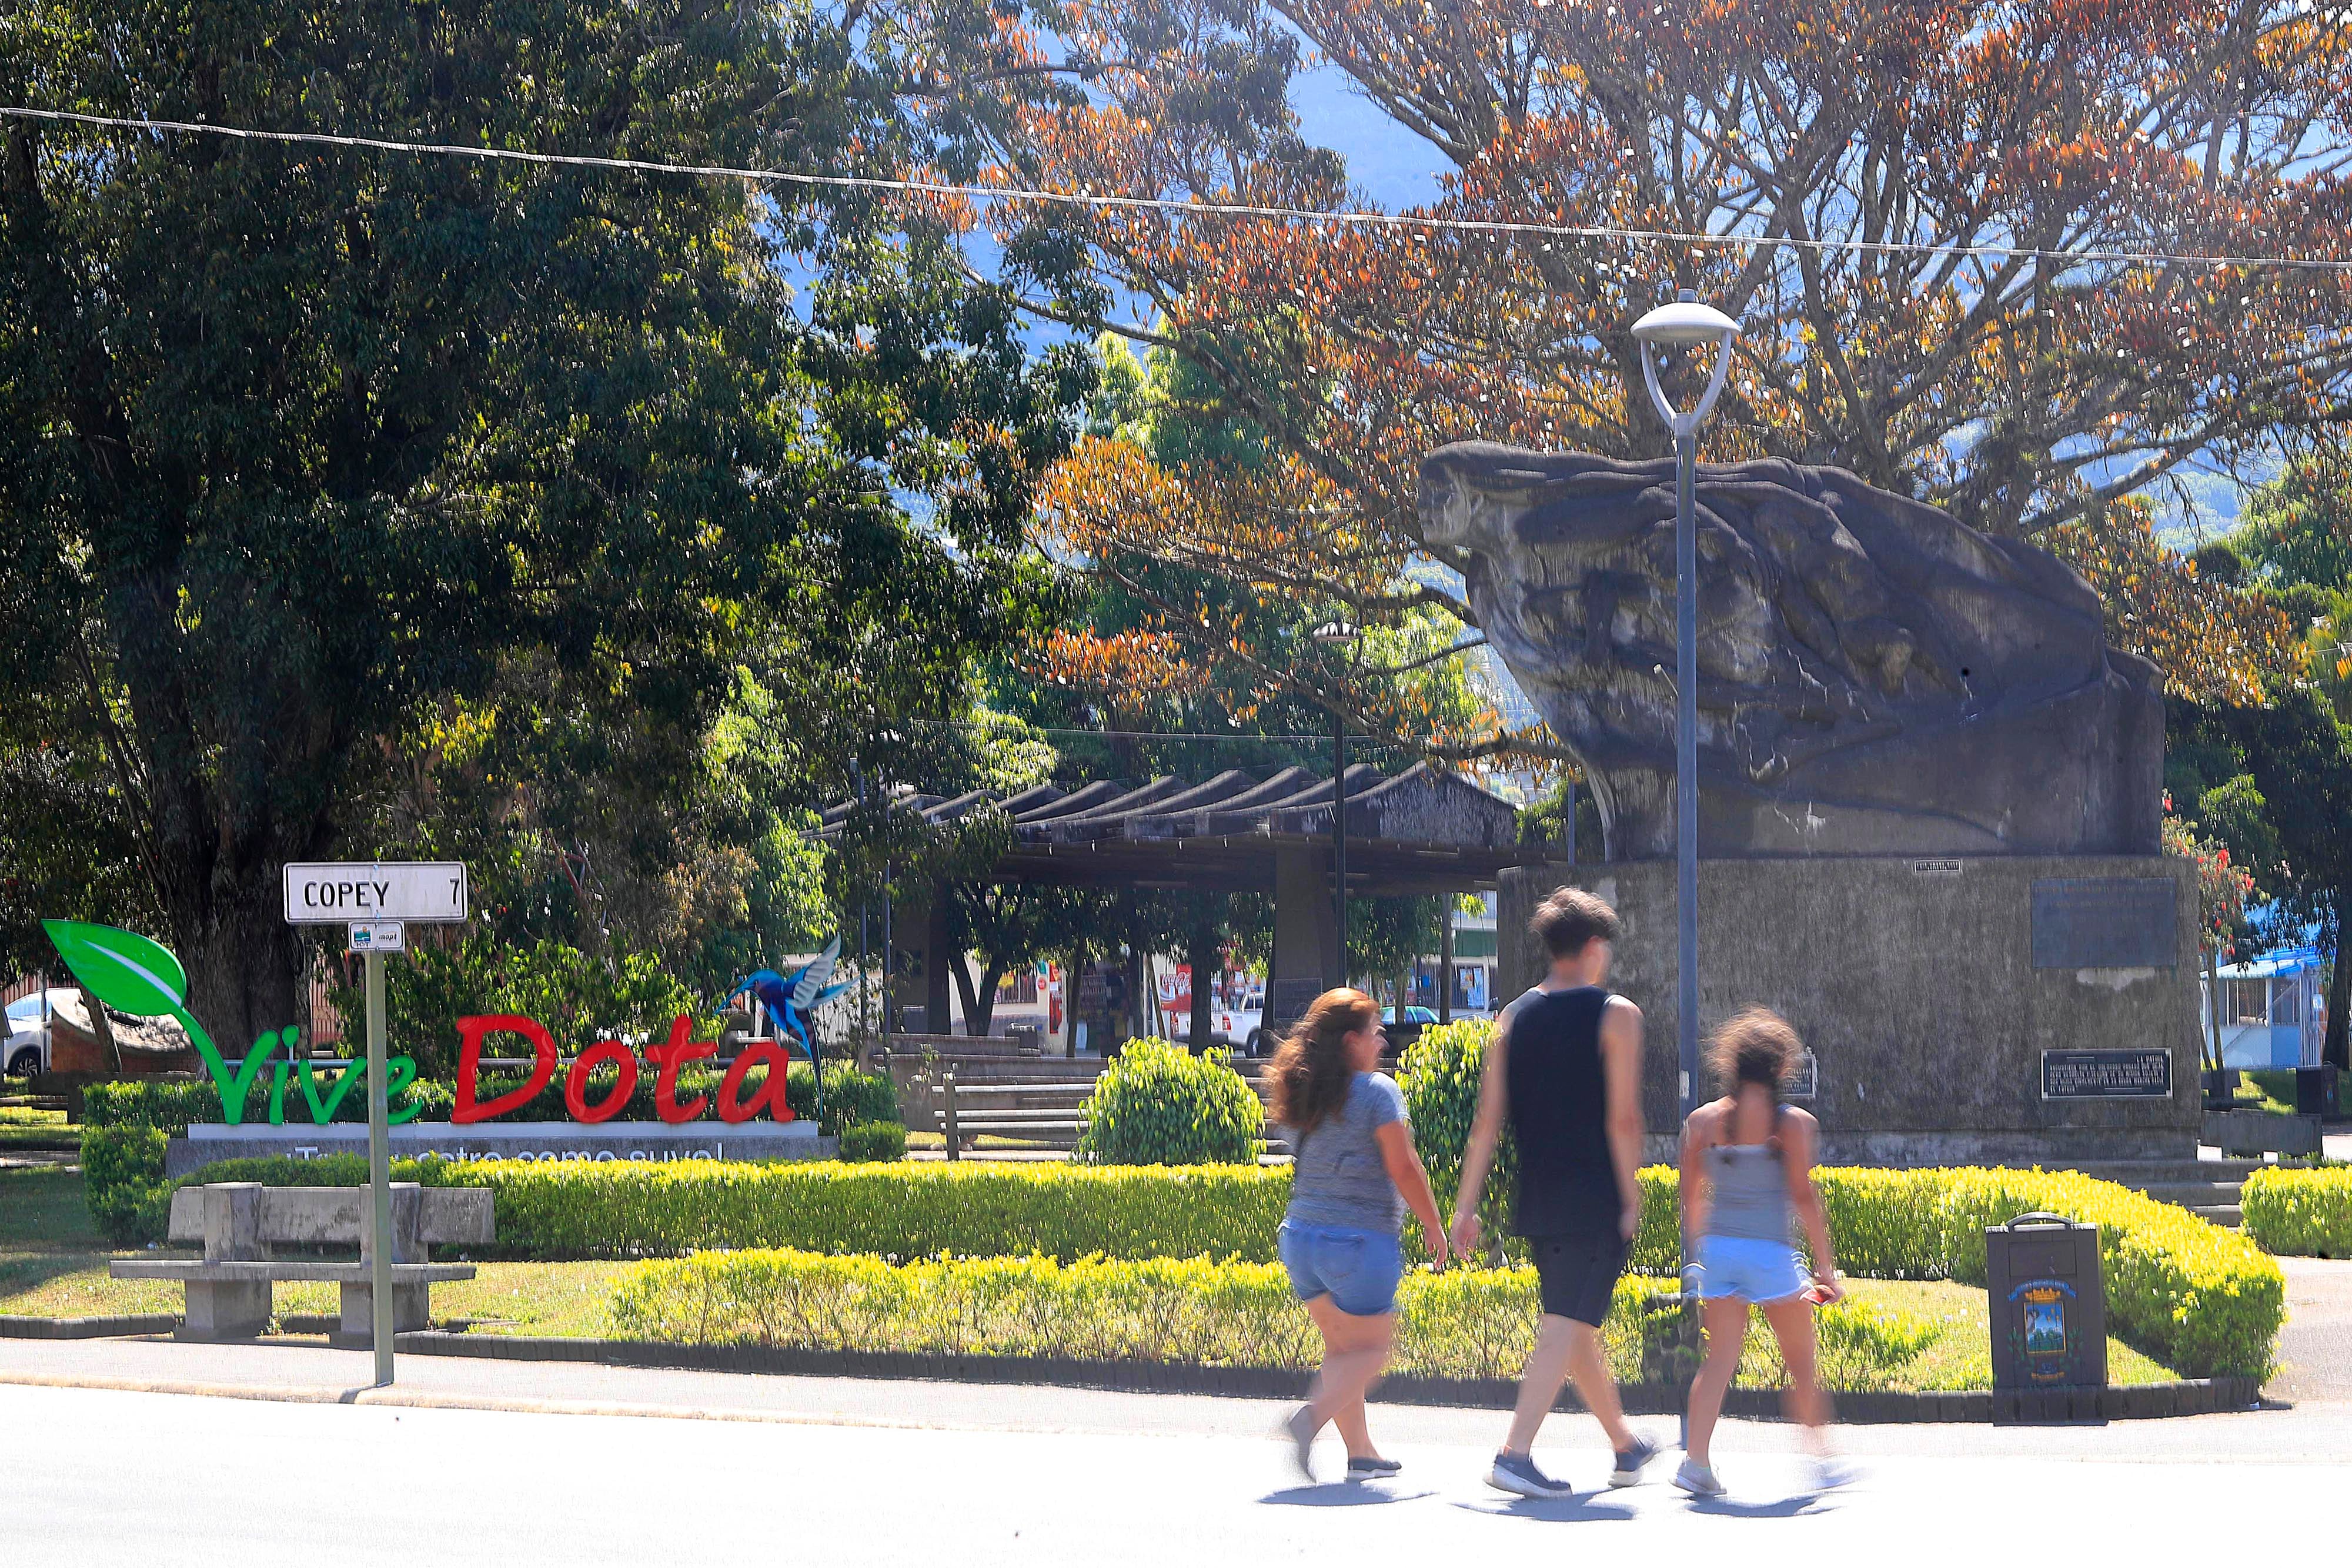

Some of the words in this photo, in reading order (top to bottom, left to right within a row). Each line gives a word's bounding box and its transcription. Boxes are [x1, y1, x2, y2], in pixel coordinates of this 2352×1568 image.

[304, 881, 390, 907] COPEY
[449, 878, 459, 905] 7
[182, 1008, 422, 1125] Vive
[452, 1014, 795, 1124] Dota
